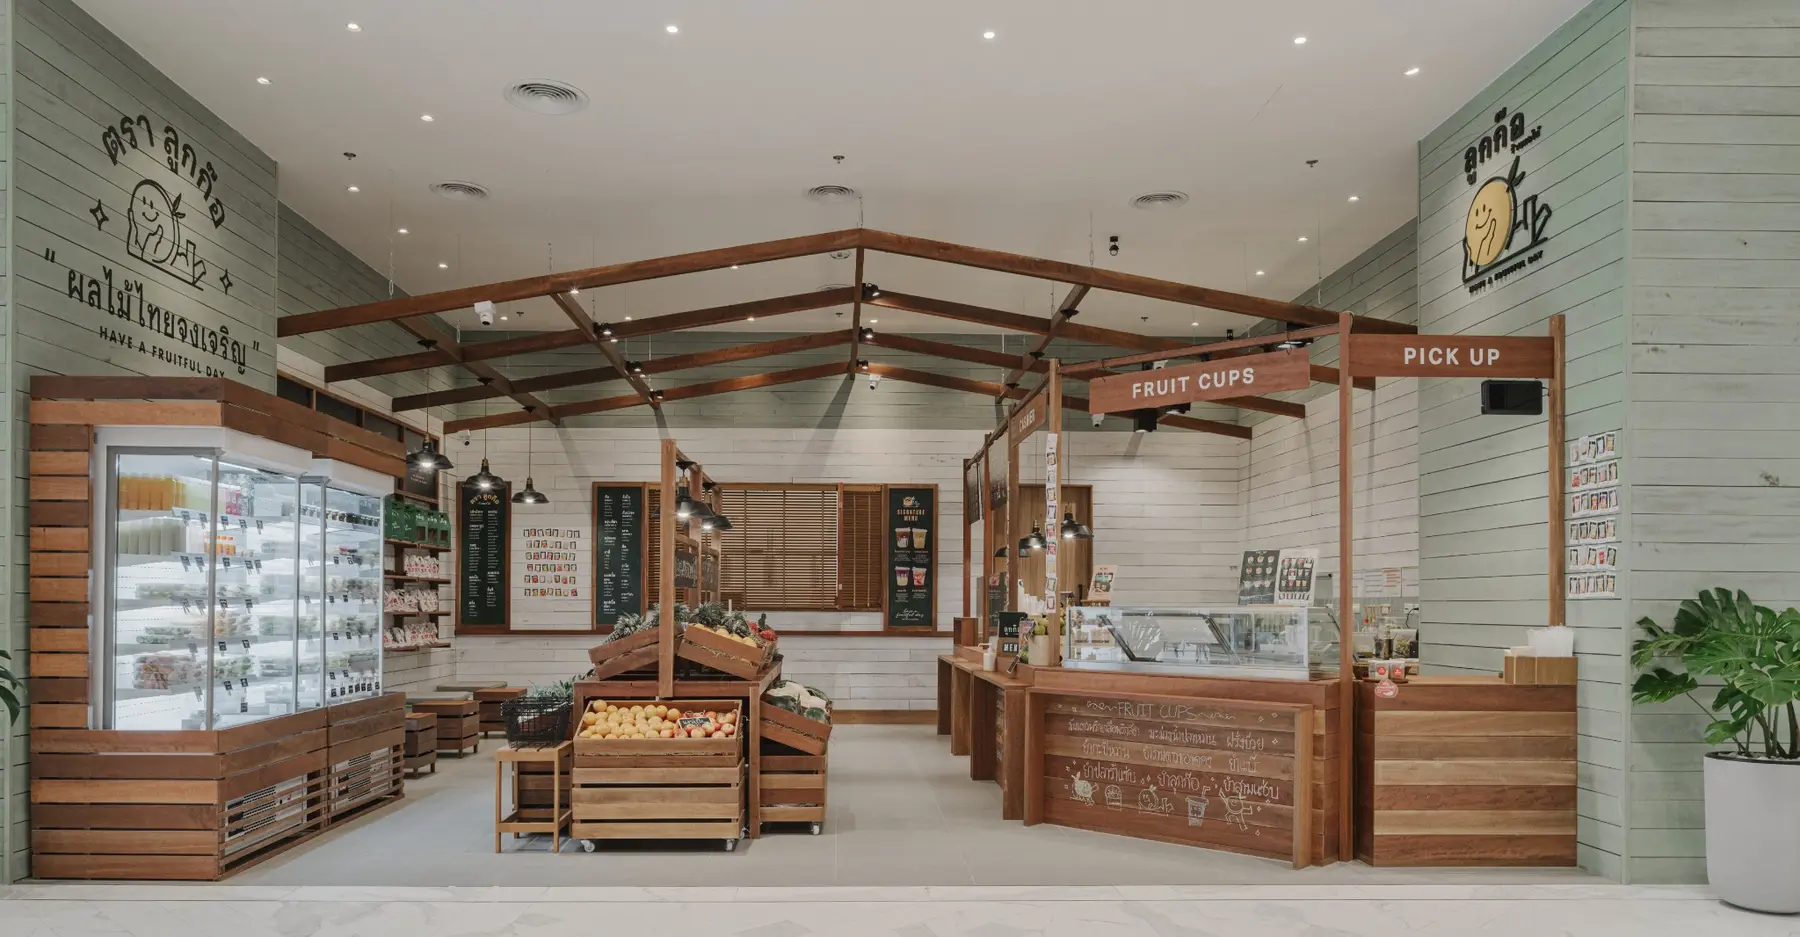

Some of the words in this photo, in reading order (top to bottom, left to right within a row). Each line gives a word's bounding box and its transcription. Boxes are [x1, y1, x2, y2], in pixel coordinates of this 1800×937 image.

[102, 114, 154, 166] ตรา
[163, 125, 225, 229] ลูกก๊อ
[100, 326, 132, 349] HAVE
[139, 341, 146, 354] A
[152, 346, 201, 373] FRUITFUL
[206, 366, 225, 378] DAY
[1404, 347, 1459, 365] PICK
[1470, 348, 1500, 366] UP
[1132, 375, 1190, 399] FRUIT
[1198, 367, 1254, 390] CUPS
[1003, 643, 1019, 652] MEN
[1117, 701, 1154, 719] FRUIT
[1160, 704, 1198, 720] CUPS
